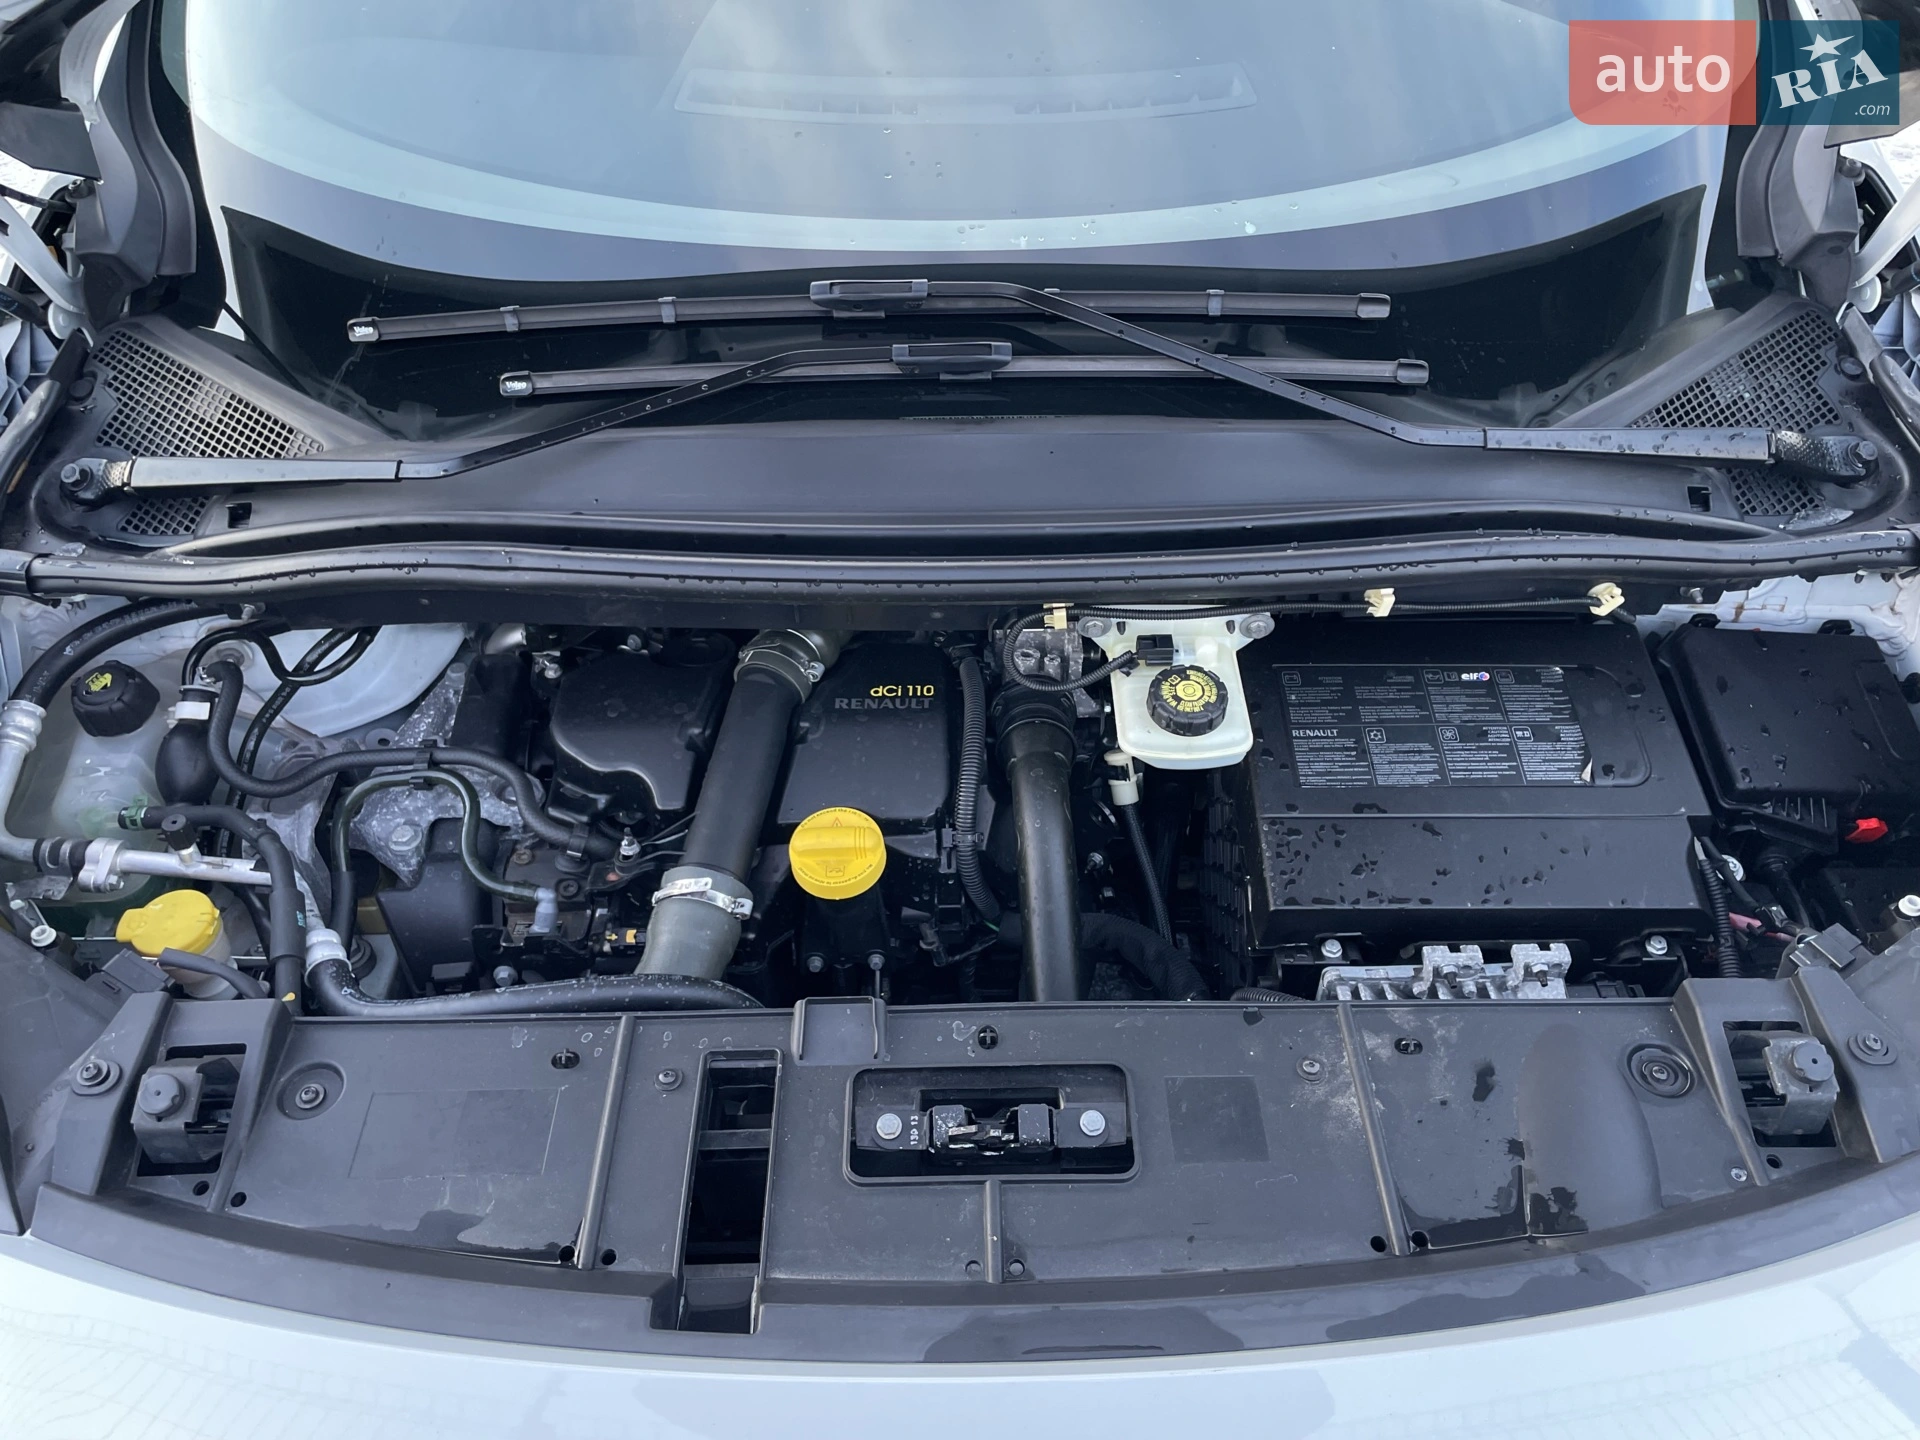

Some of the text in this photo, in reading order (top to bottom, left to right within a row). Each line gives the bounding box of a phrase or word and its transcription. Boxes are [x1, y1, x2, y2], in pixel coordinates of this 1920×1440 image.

[1461, 672, 1479, 681] elf
[870, 685, 935, 697] dCi 110
[834, 697, 934, 709] RENAULT
[1292, 729, 1338, 737] RENAULT
[910, 1115, 919, 1126] 13
